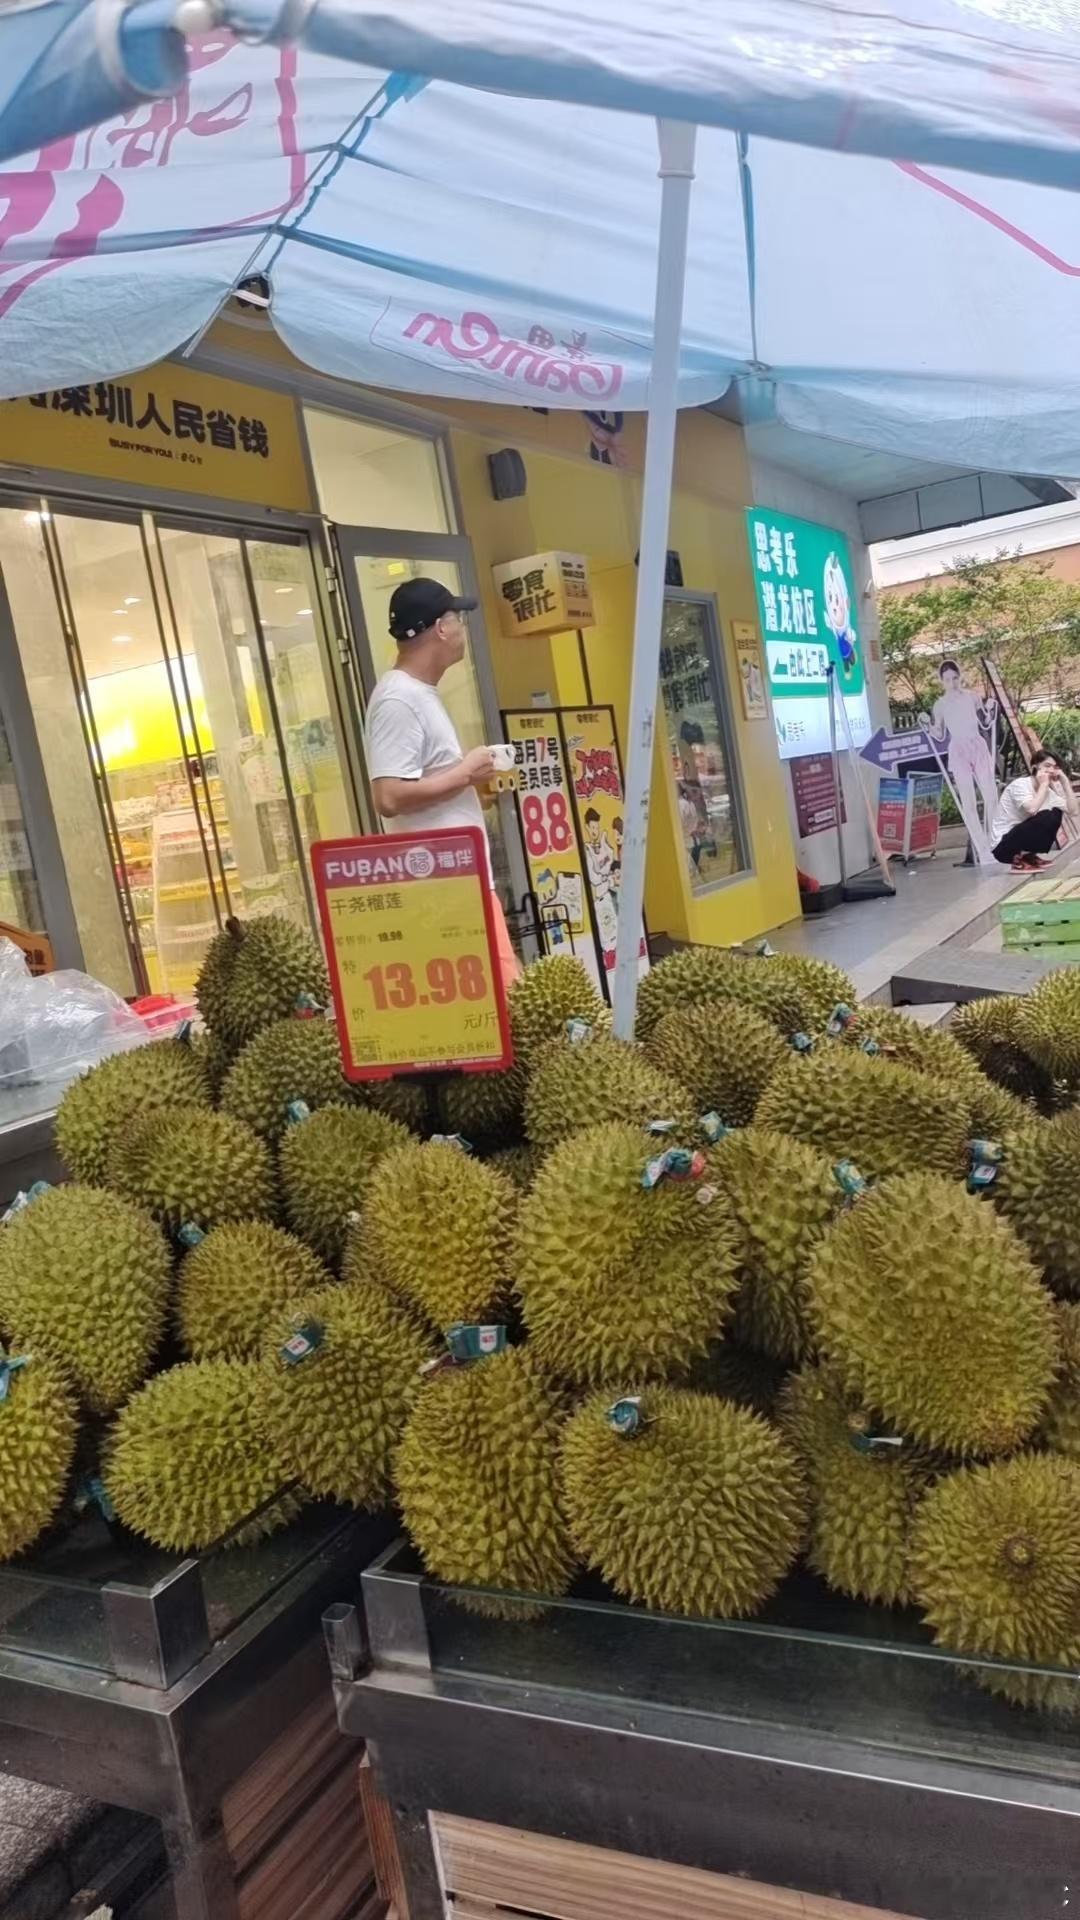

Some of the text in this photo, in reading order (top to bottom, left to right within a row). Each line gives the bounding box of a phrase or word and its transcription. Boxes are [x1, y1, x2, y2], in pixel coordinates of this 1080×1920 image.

[8, 382, 270, 458] 深圳人民省钱
[754, 521, 798, 578] 思考乐
[512, 589, 557, 623] 很忙
[523, 791, 571, 857] 88
[325, 855, 404, 880] FUBAN
[437, 849, 473, 869] 福伴
[330, 892, 404, 916] 干尧榴莲
[363, 954, 488, 1011] 13.98
[464, 1010, 498, 1031] 元/斤
